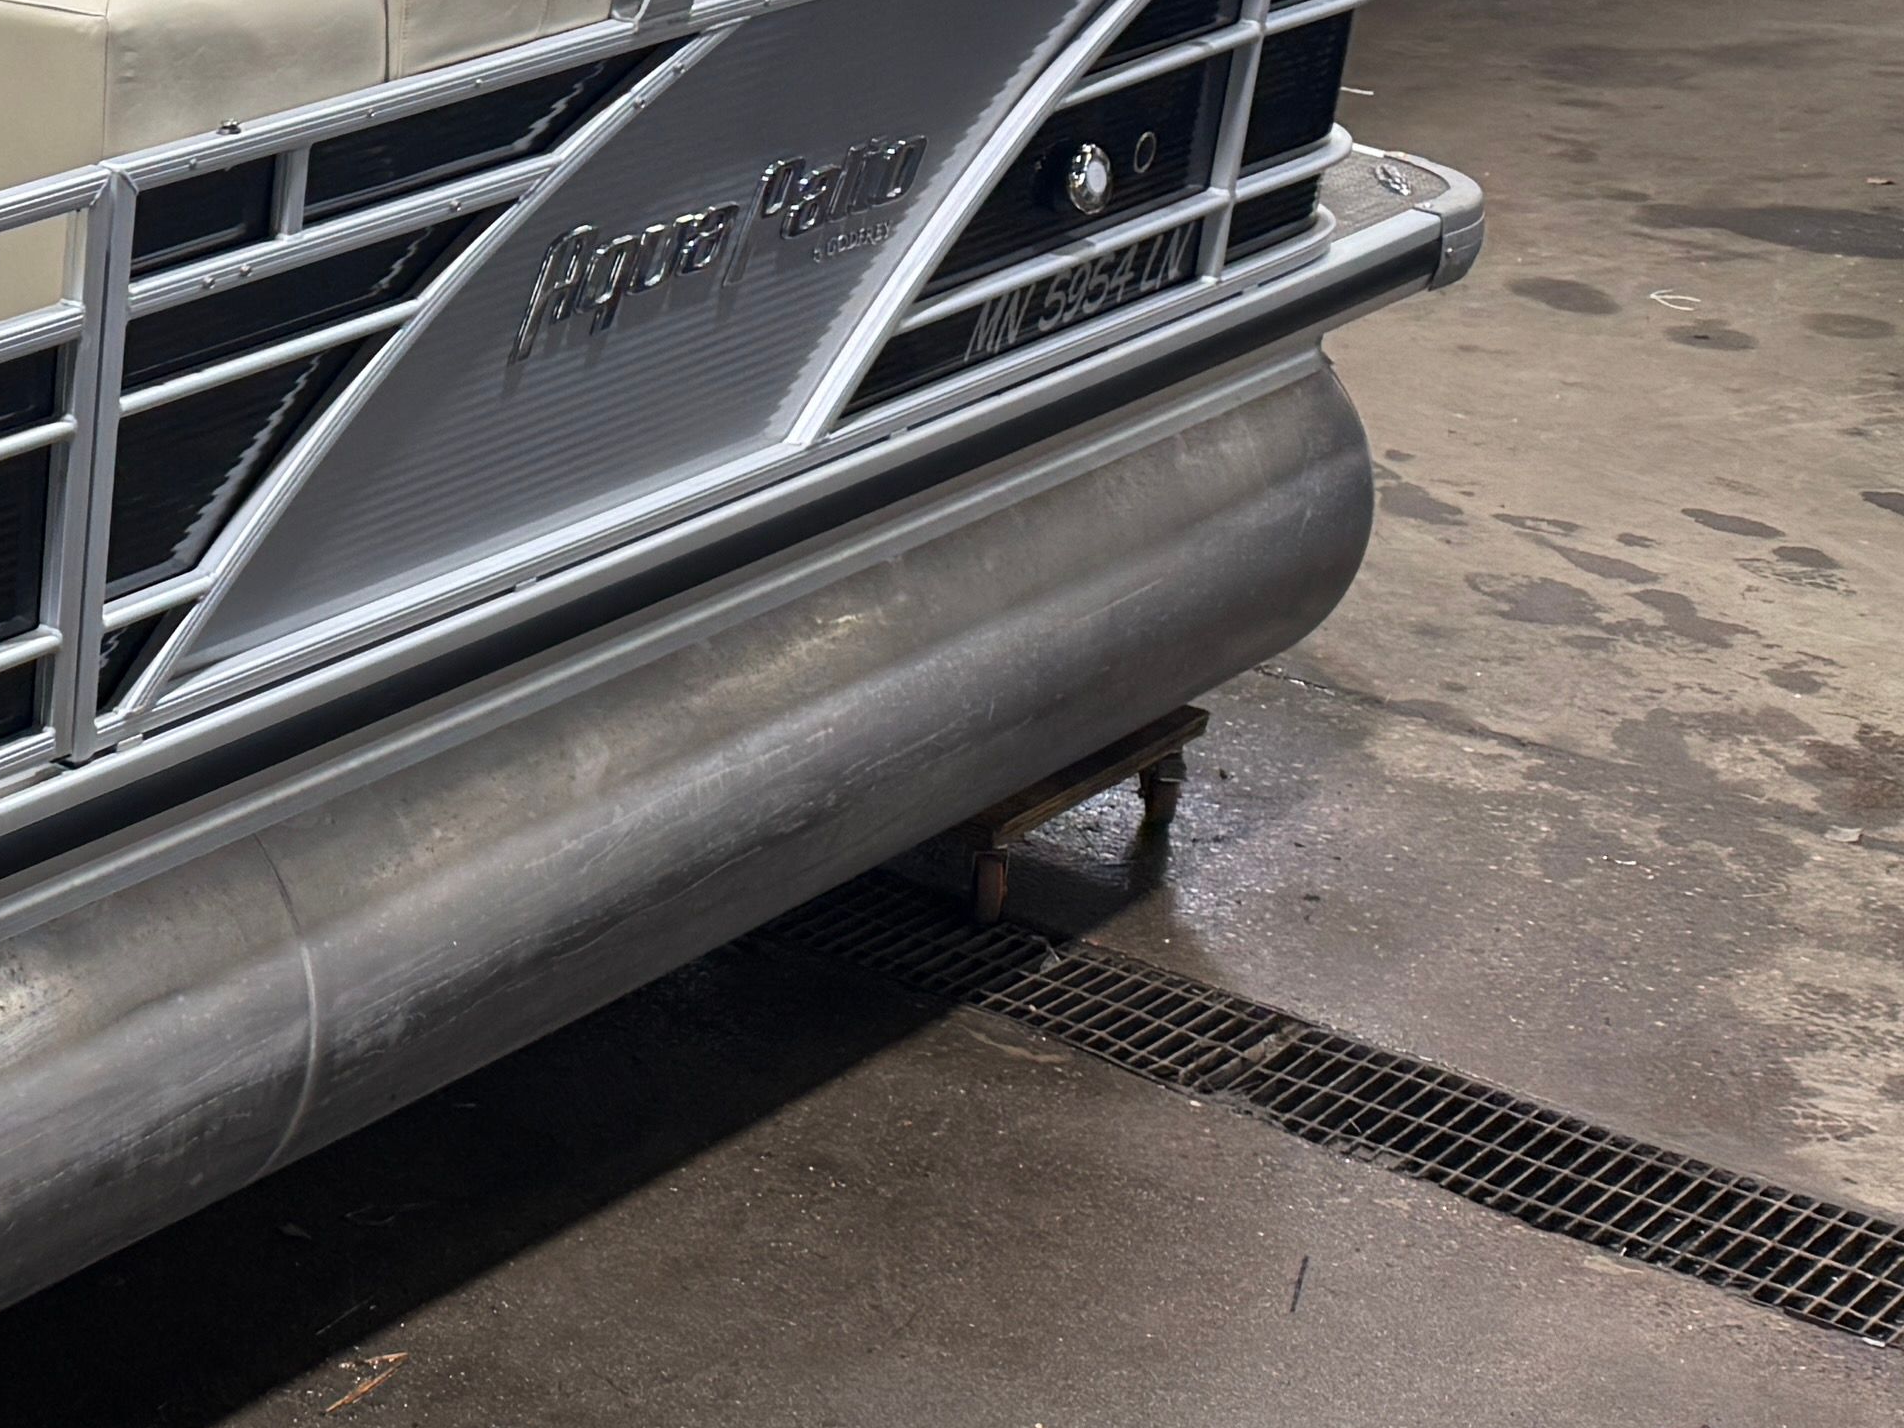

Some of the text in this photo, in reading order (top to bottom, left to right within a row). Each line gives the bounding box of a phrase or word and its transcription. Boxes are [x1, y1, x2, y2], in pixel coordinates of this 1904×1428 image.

[964, 218, 1198, 362] MN 5954 LN
